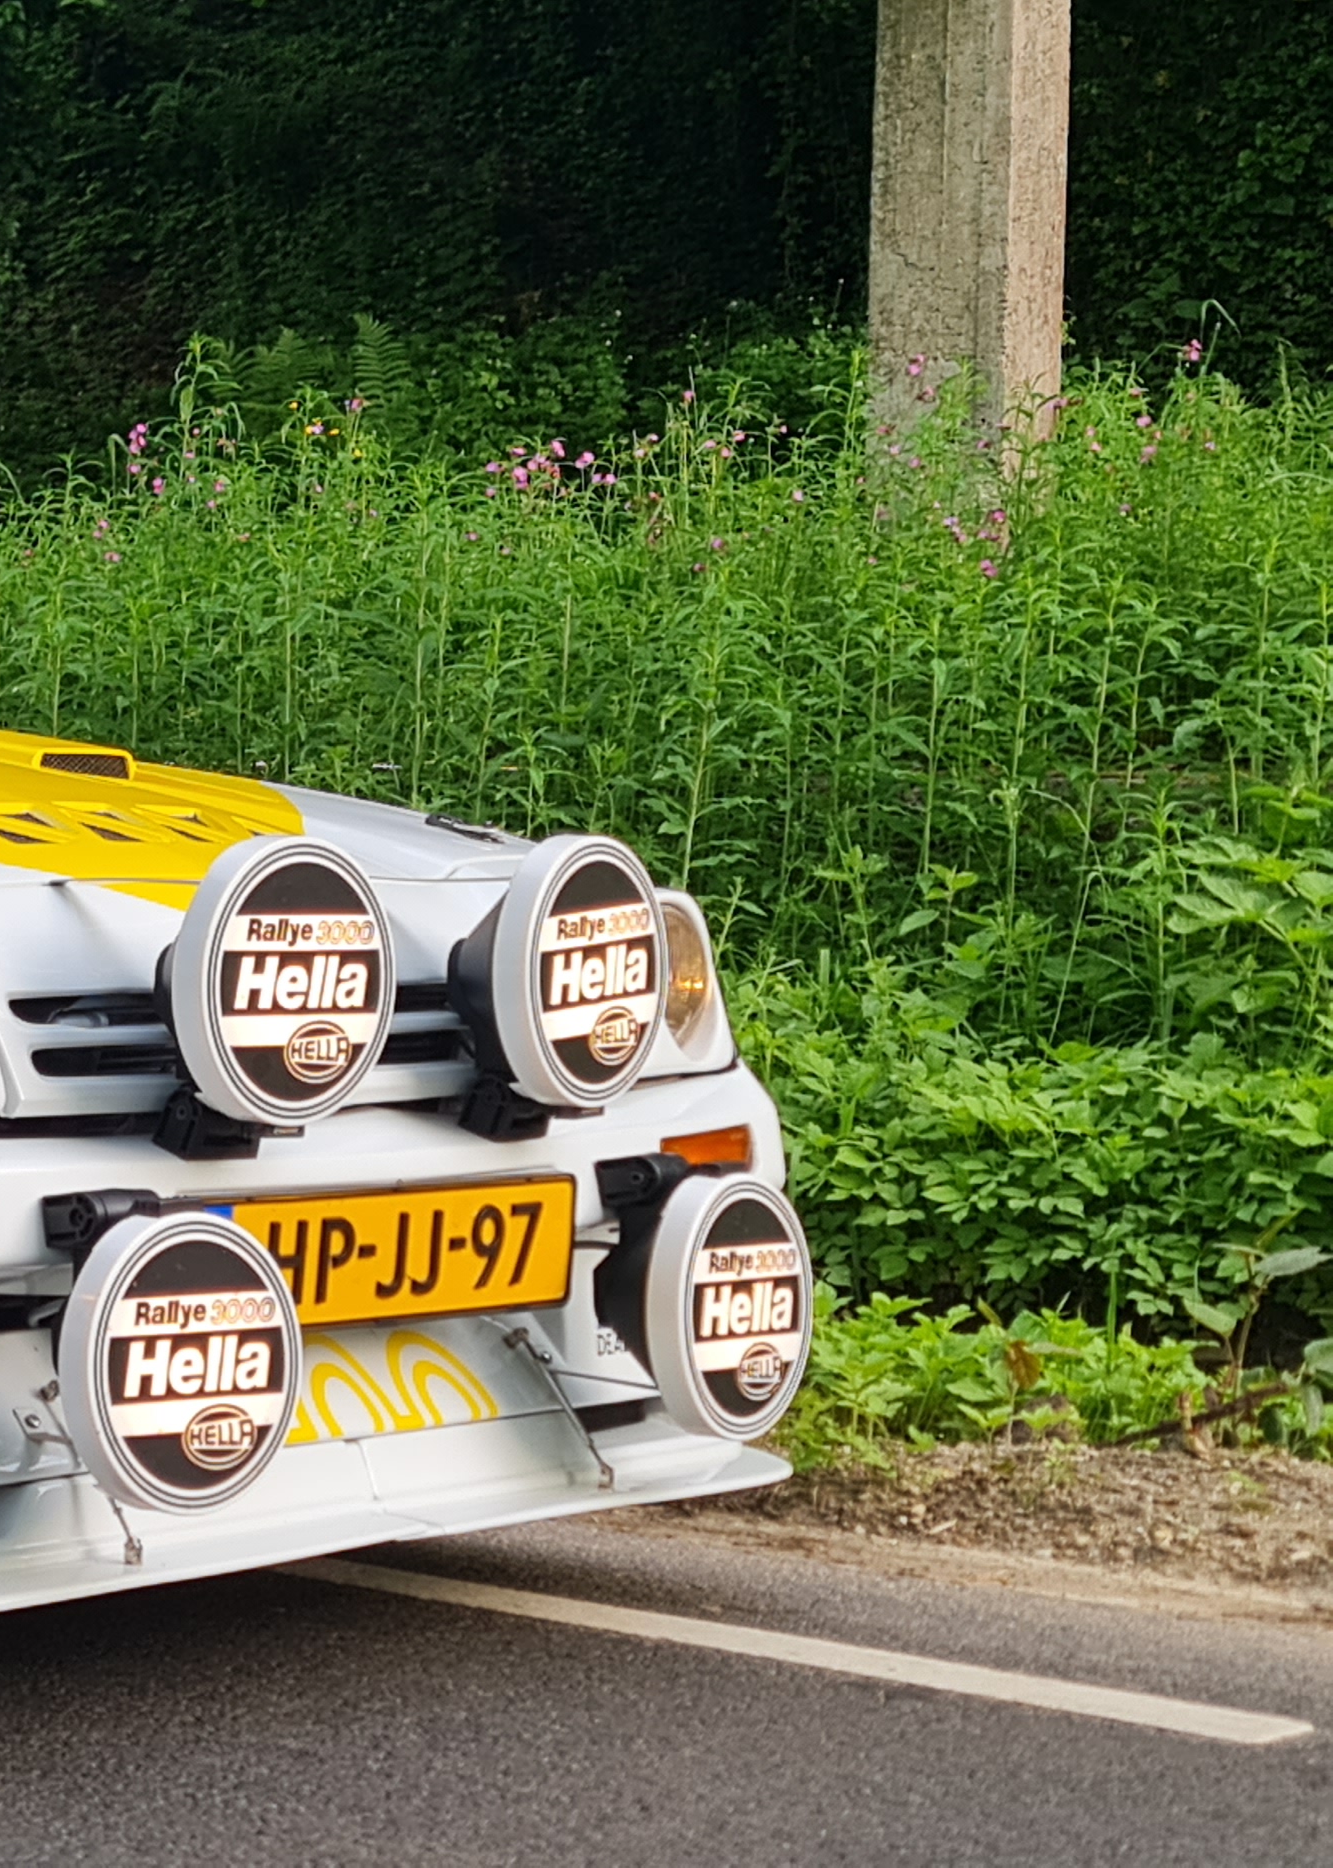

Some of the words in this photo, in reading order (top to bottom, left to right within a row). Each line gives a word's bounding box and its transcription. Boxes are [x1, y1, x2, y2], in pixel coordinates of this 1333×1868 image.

[246, 918, 313, 947] Rallye
[316, 920, 375, 945] 3000
[556, 916, 605, 941] Rallye
[233, 955, 368, 1010] Hella
[549, 943, 648, 1006] Hella
[592, 1018, 639, 1045] HELLA
[290, 1037, 350, 1064] HELLA
[269, 1201, 542, 1306] HP-JJ-97
[709, 1251, 753, 1276] Rallye
[134, 1300, 206, 1329] Rallye
[210, 1297, 276, 1325] 3000
[700, 1280, 794, 1337] Hella
[123, 1335, 271, 1399] Hella
[284, 1330, 498, 1445] 00
[189, 1418, 255, 1447] HELLA
